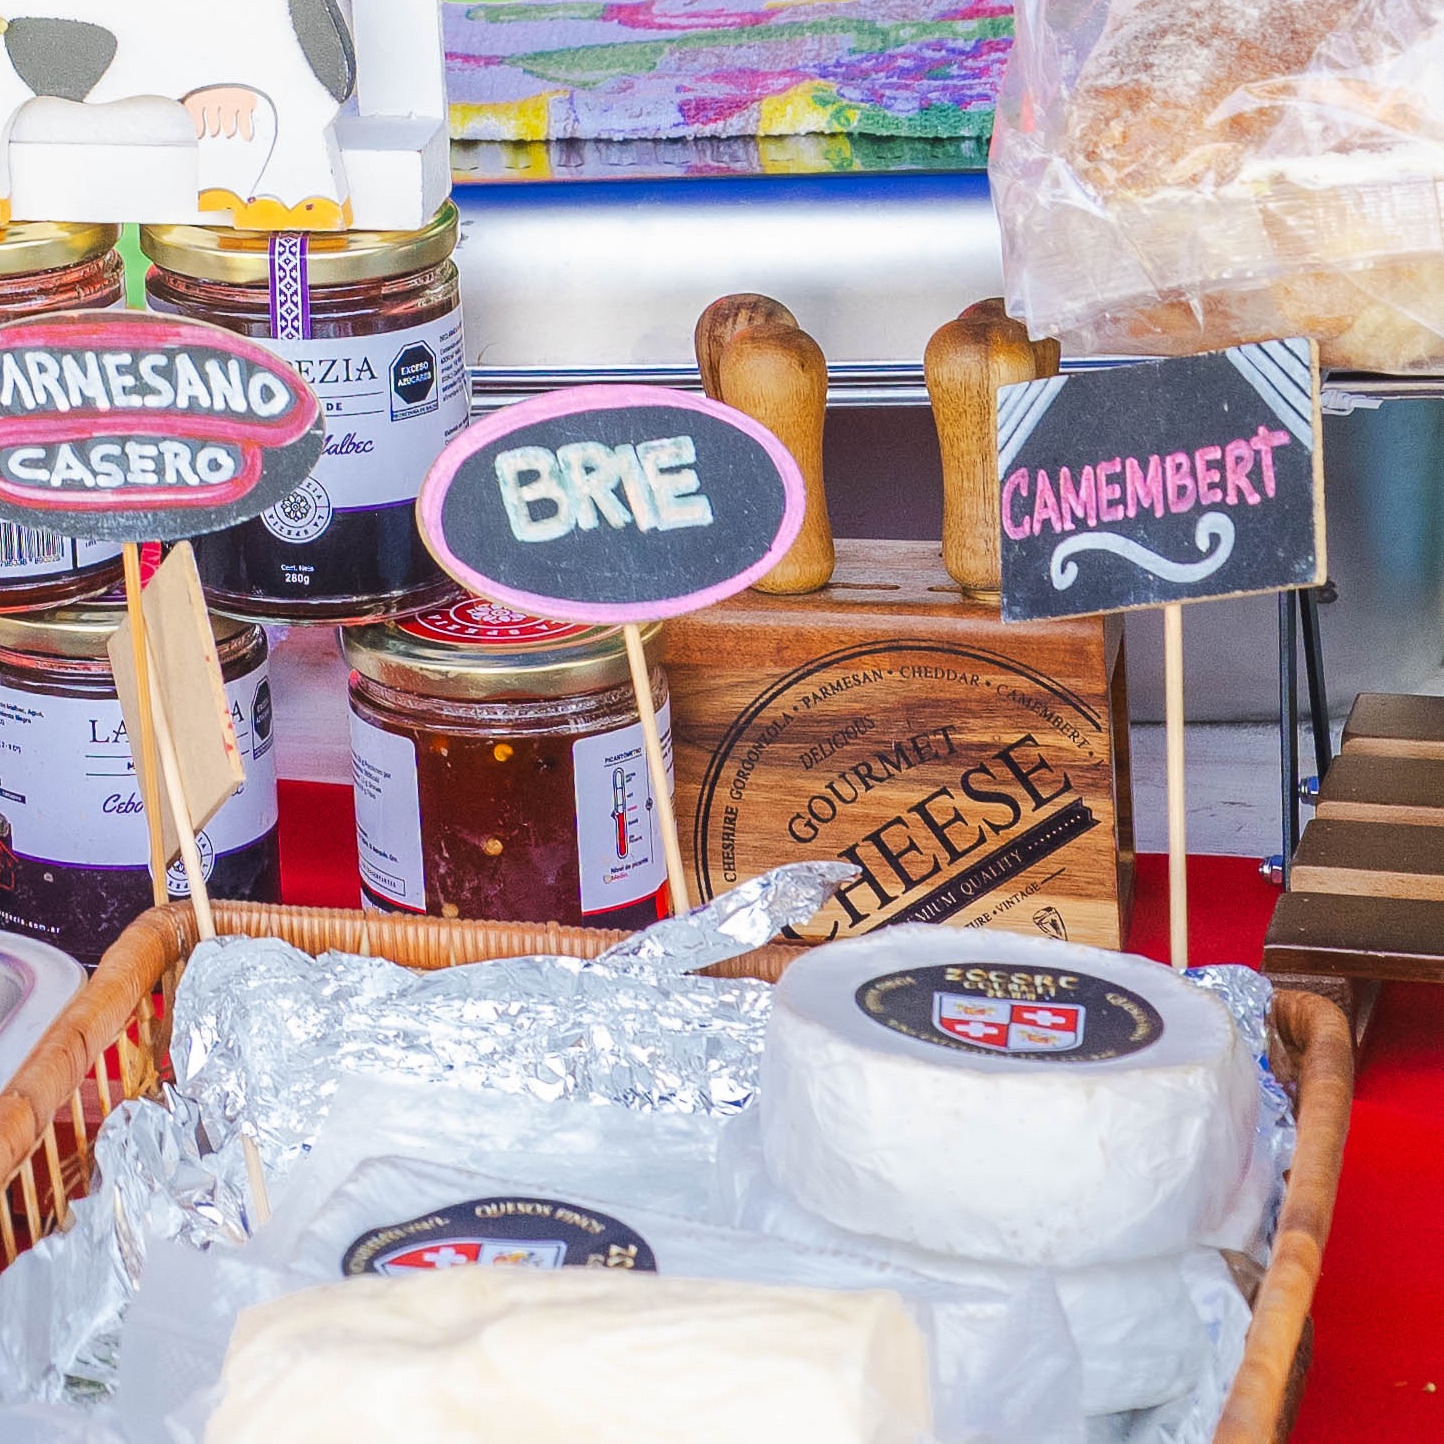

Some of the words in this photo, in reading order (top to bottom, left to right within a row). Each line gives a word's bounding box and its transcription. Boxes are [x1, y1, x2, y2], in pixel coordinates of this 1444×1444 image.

[296, 356, 378, 384] EZIA
[401, 361, 429, 375] EXCESO
[326, 402, 344, 412] DE
[7, 439, 236, 490] CASERO
[493, 434, 715, 543] BRIE
[1002, 424, 1291, 541] CAMEMBERT
[285, 573, 310, 585] 280g
[801, 668, 884, 710] PARMESAN
[900, 665, 981, 688] CHEDDAR
[996, 683, 1091, 750] CAMEMBERT
[731, 712, 795, 801] GORGONZOLA
[800, 714, 877, 771] DELICIOUS
[788, 725, 959, 844] GOURMET
[724, 806, 740, 884] CHESHIRE
[960, 849, 1023, 897] QUALITY
[994, 881, 1041, 912] VINTAGE
